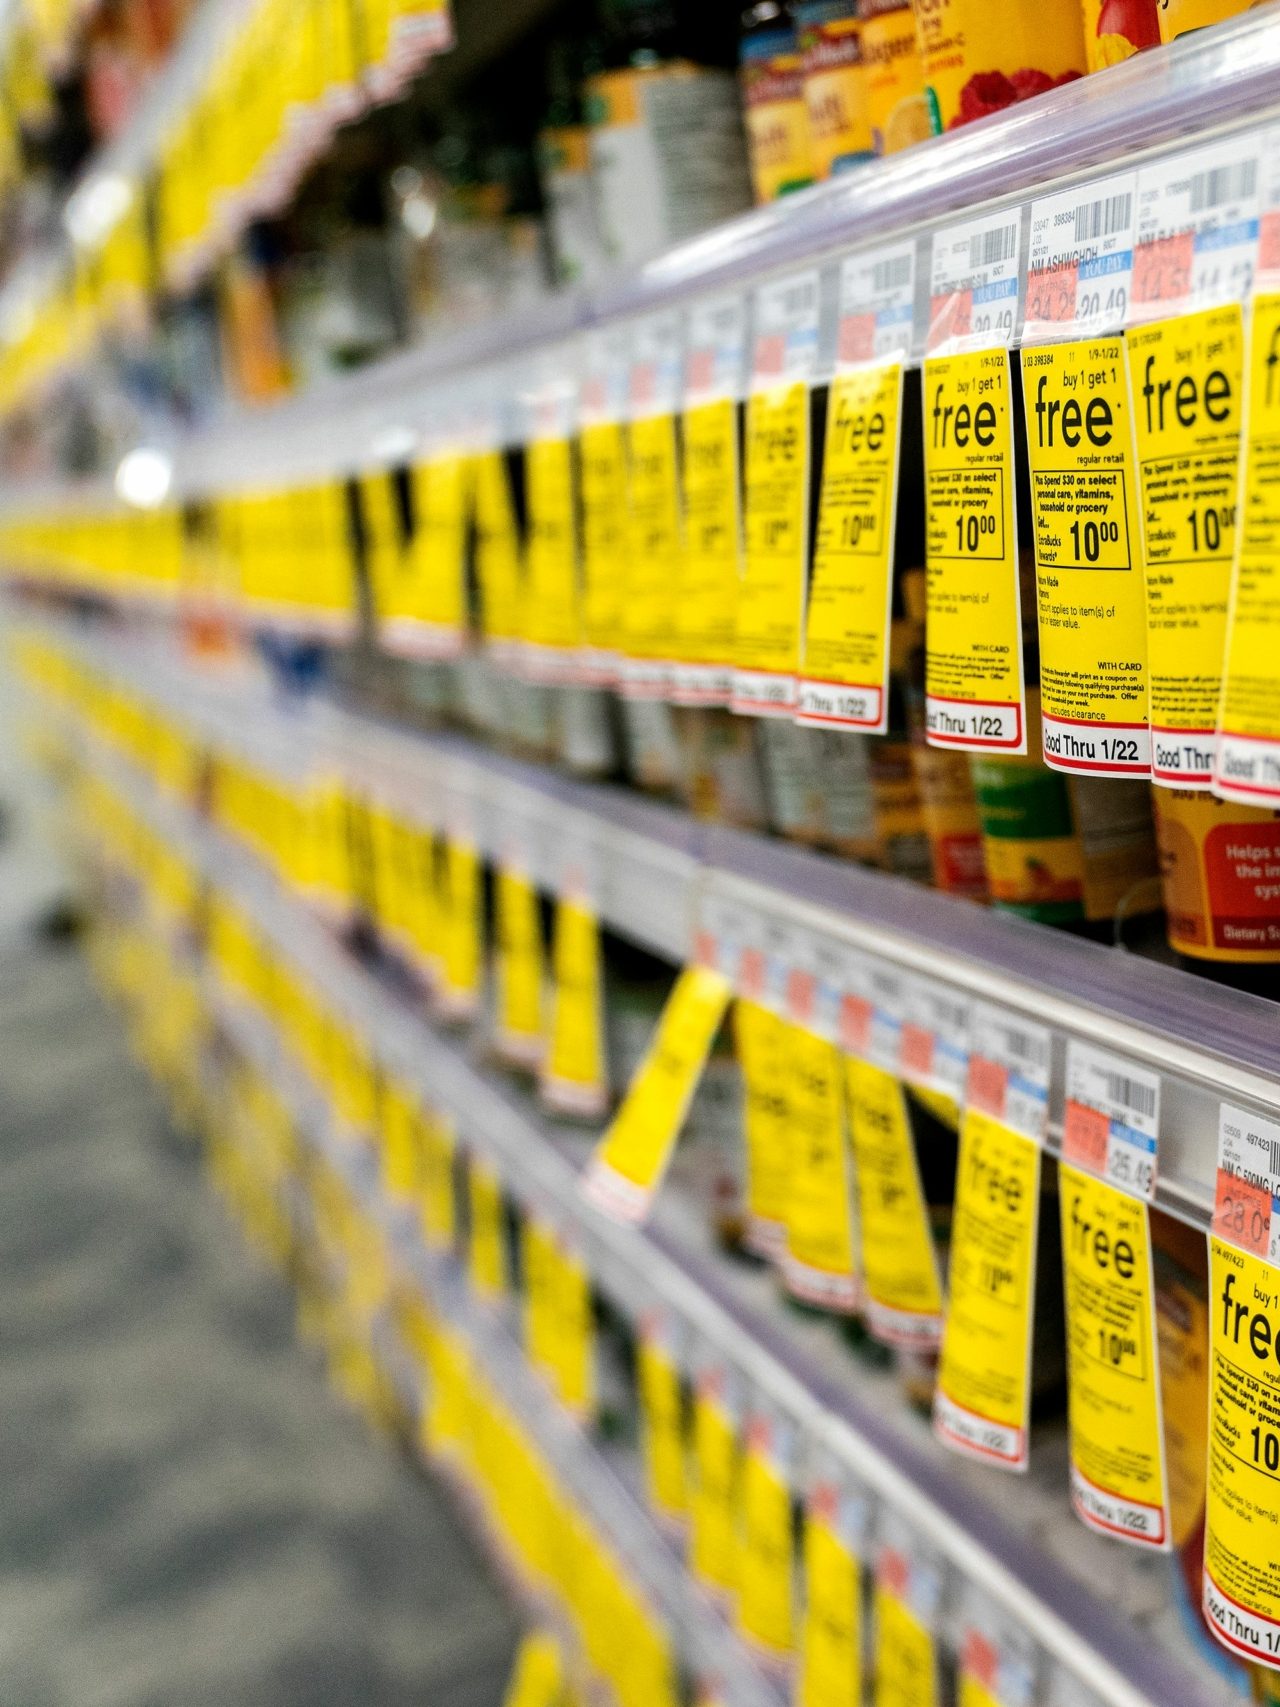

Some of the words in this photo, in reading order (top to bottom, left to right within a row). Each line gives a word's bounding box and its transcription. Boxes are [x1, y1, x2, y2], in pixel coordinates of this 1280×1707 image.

[1053, 210, 1075, 227] 398384
[1031, 259, 1044, 277] NM
[1034, 354, 1054, 366] 398384
[1089, 347, 1119, 360] 1/9-1/22
[957, 379, 970, 396] buy
[978, 377, 994, 394] get
[1063, 370, 1078, 390] buy
[1080, 369, 1085, 385] 1
[1088, 370, 1107, 389] get
[1111, 367, 1116, 383] 1
[1143, 355, 1231, 434] free
[933, 383, 997, 449] free
[1035, 375, 1113, 448] free
[1077, 453, 1101, 466] regular
[1103, 452, 1124, 463] retail
[973, 472, 997, 482] select
[1044, 475, 1060, 488] Spend
[1062, 474, 1075, 485] $30
[1076, 477, 1085, 485] on
[1088, 475, 1117, 485] select
[1057, 490, 1073, 500] care,
[1075, 488, 1114, 500] vitamins,
[1040, 501, 1064, 512] household
[1066, 504, 1074, 512] or
[1075, 503, 1108, 515] grocery
[1051, 603, 1069, 617] applies
[1070, 605, 1077, 616] to
[1079, 605, 1104, 618] item(s)
[1106, 606, 1115, 617] of
[990, 645, 1010, 654] CARD
[1098, 661, 1117, 670] WITH
[1118, 662, 1142, 671] CARD
[1085, 682, 1110, 691] qualifying
[1111, 683, 1144, 692] purchase(s)
[1105, 675, 1127, 683] coupon
[1071, 708, 1106, 720] clearance
[940, 712, 966, 734] Thru
[971, 717, 1003, 737] 1/22
[1045, 729, 1061, 753] Good
[1063, 734, 1096, 758] Thru
[1100, 738, 1139, 761] 1/22
[1156, 744, 1180, 768] Good
[1226, 844, 1272, 862] Helps
[1236, 863, 1262, 879] the
[1246, 1132, 1270, 1152] 497423
[1222, 1158, 1234, 1178] NM
[1235, 1165, 1242, 1182] C
[1243, 1169, 1269, 1194] 500MG
[1253, 1283, 1271, 1308] buy
[1274, 1295, 1278, 1309] 1
[1246, 1378, 1259, 1392] $30
[1261, 1389, 1271, 1399] on
[1228, 1611, 1259, 1645] Thru
